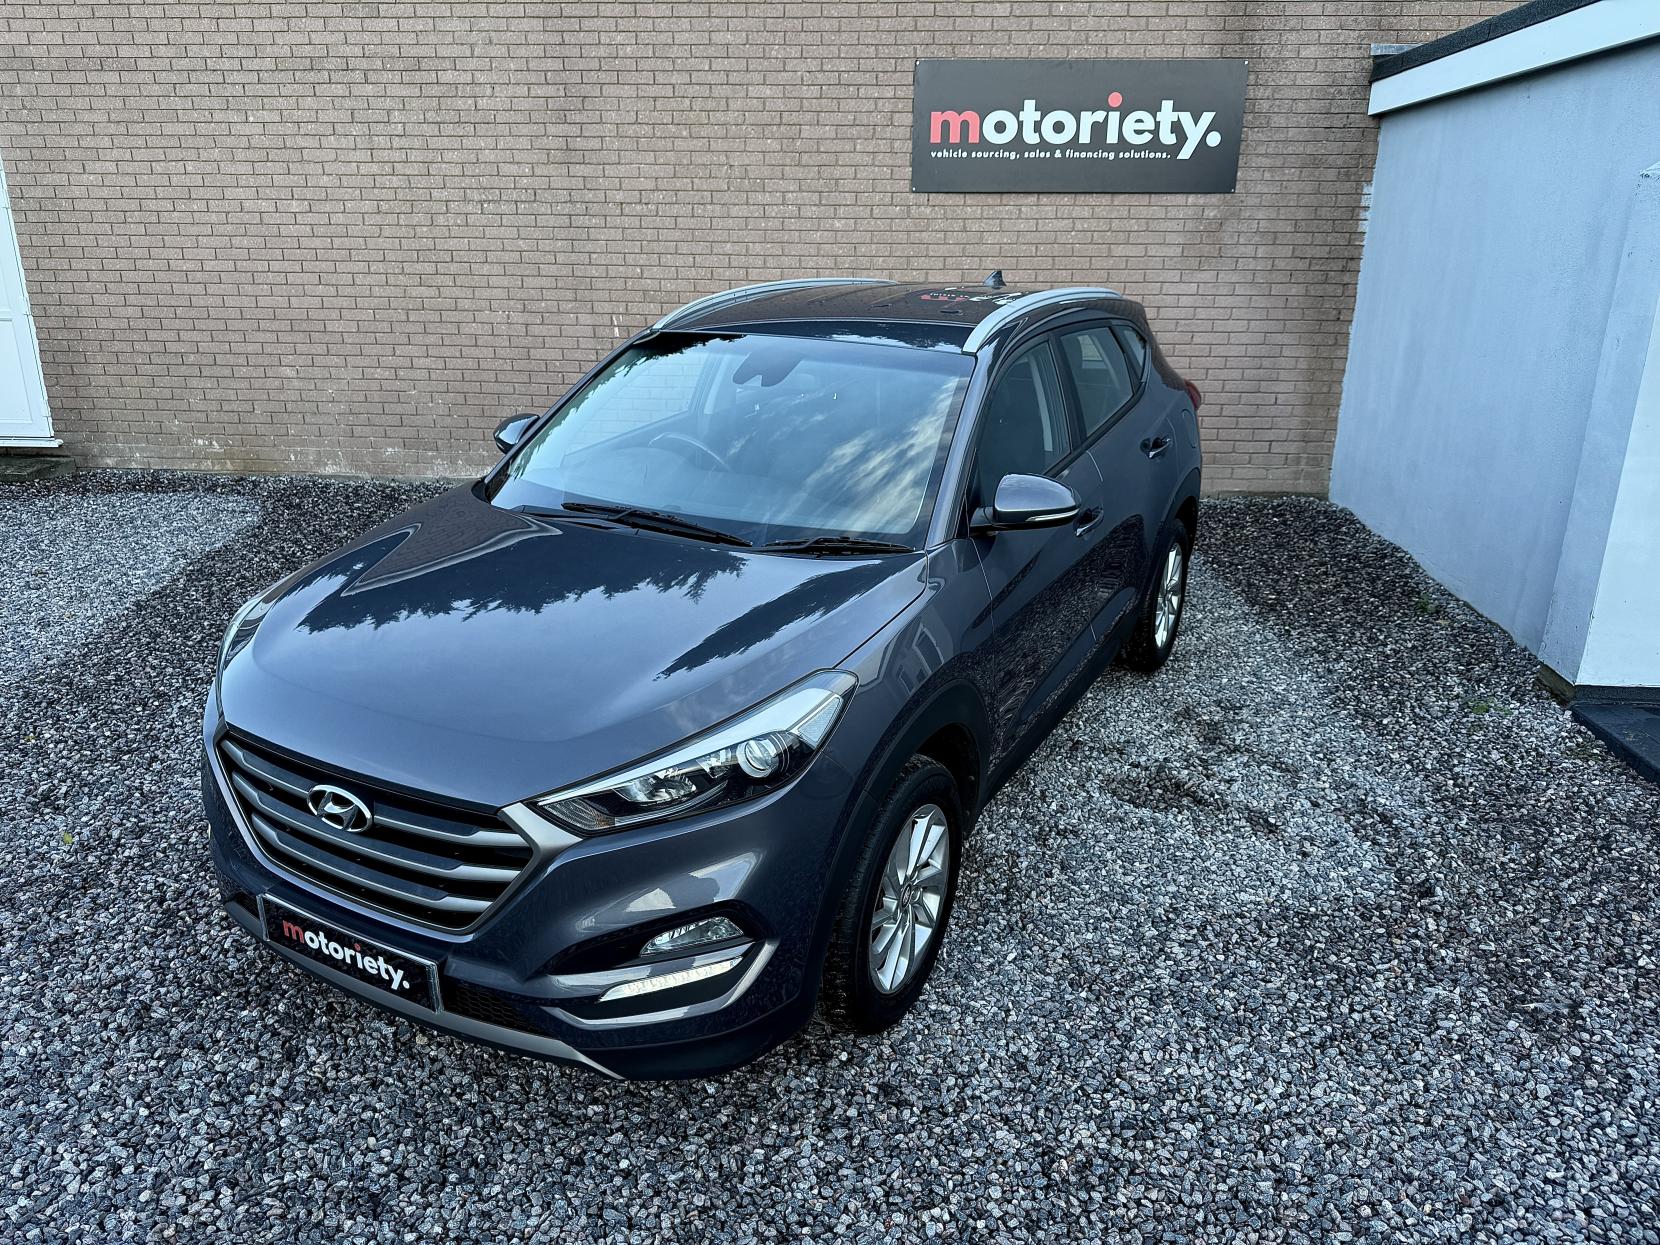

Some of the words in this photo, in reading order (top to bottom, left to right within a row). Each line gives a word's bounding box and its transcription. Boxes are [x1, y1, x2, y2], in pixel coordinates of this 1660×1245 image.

[930, 92, 1222, 160] motoriety.
[930, 148, 968, 159] vehicle
[971, 148, 1020, 160] sourcing,
[1024, 148, 1051, 159] sales
[1054, 149, 1063, 159] &
[1065, 148, 1116, 161] financing
[1118, 149, 1171, 159] solutions.
[282, 919, 411, 991] motoriety.
